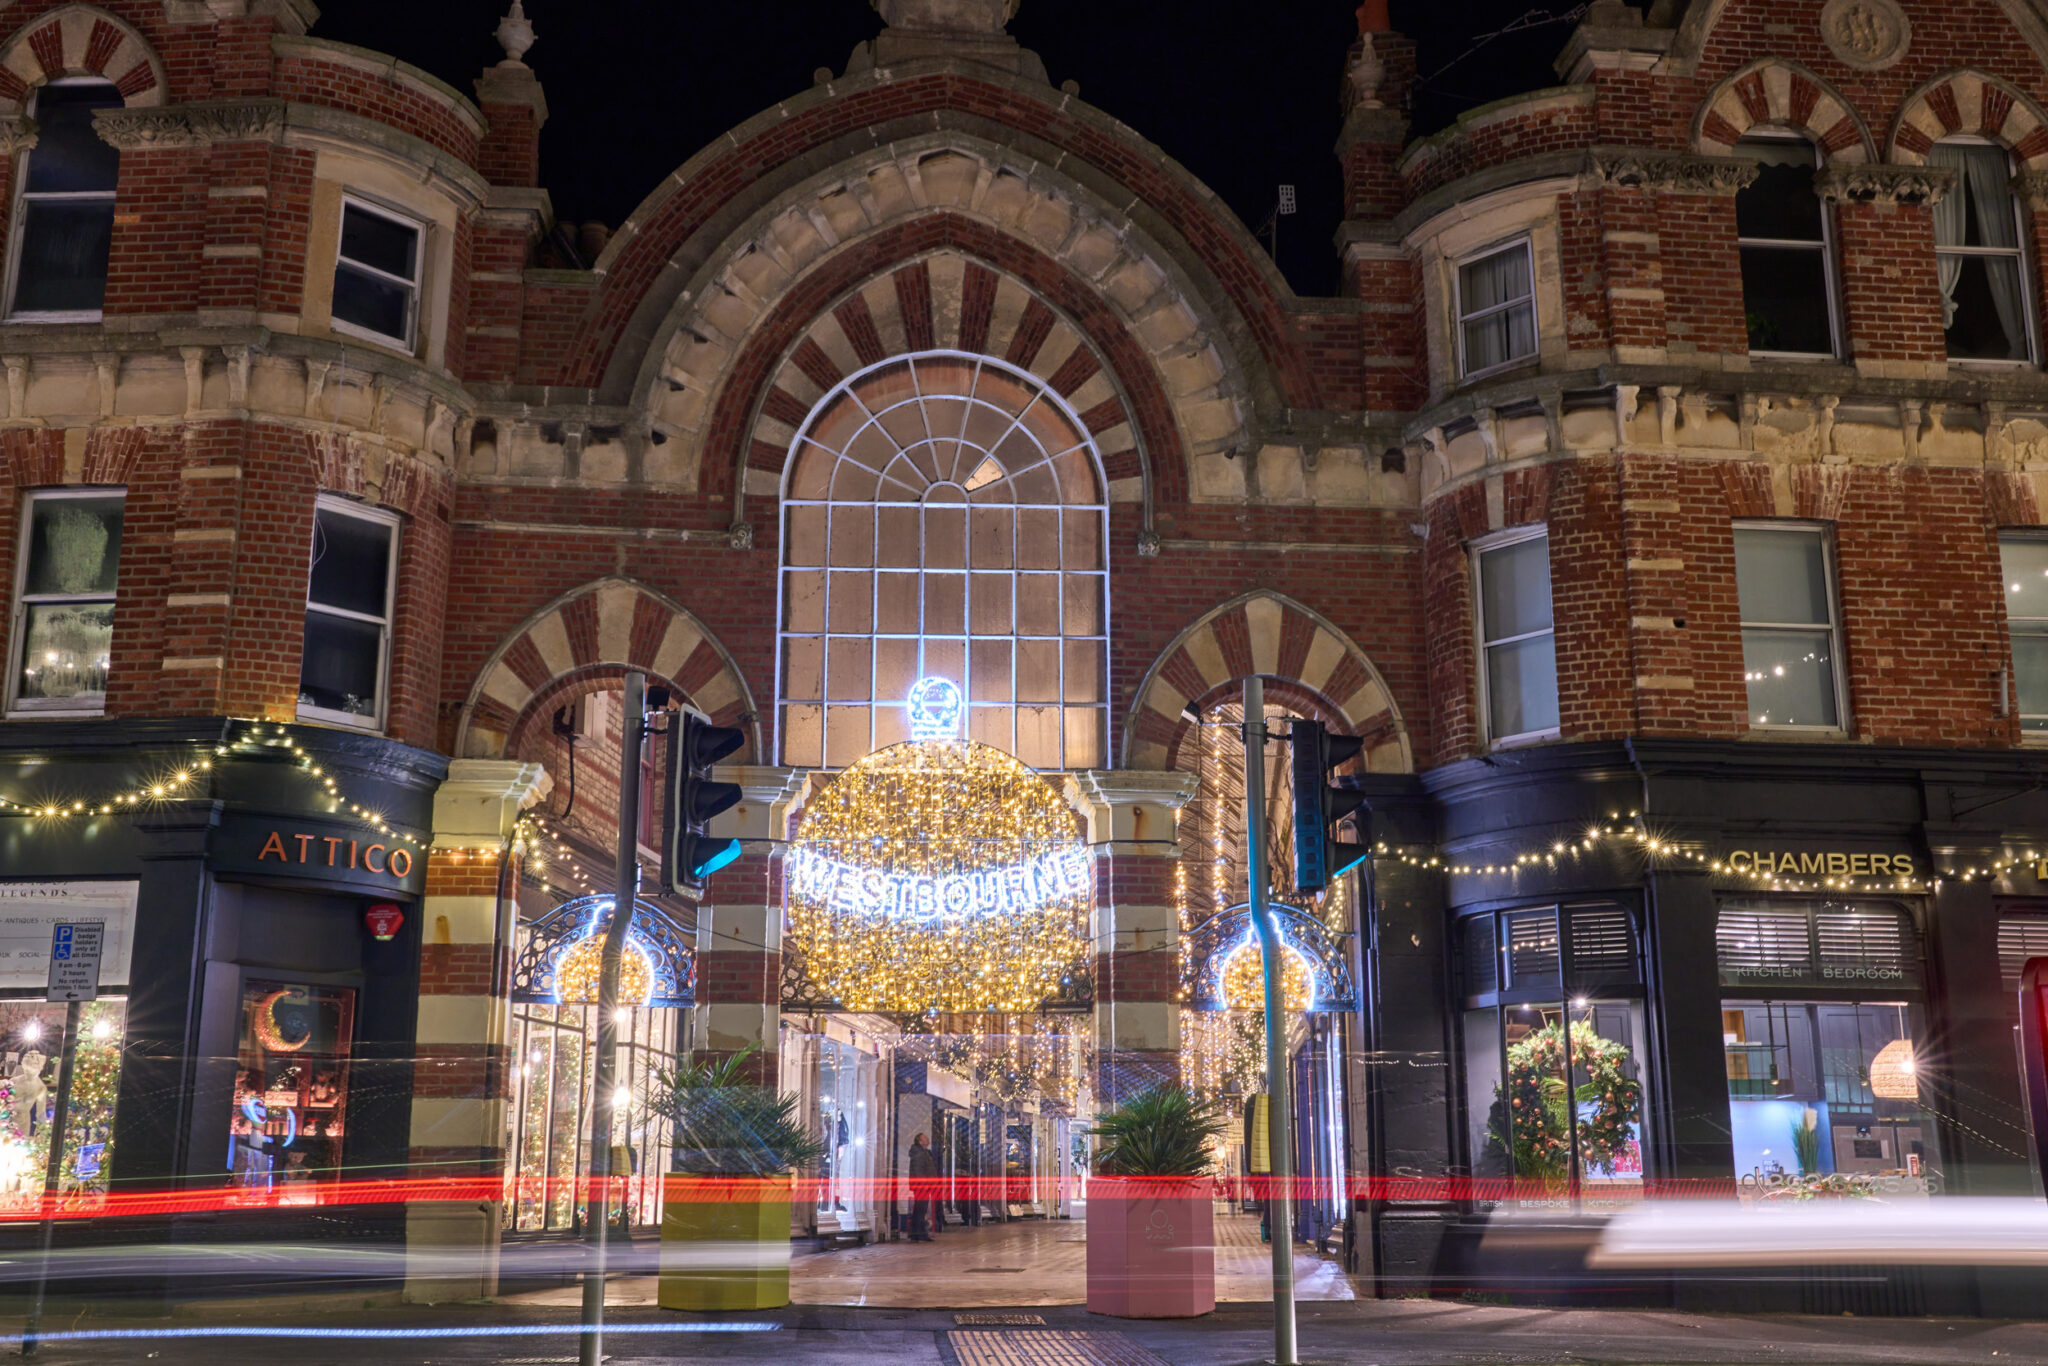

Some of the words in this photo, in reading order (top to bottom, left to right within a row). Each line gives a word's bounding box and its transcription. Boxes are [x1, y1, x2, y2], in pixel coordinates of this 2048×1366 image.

[257, 831, 413, 878] ATTICO
[1729, 850, 1914, 876] CHAMBERS
[788, 846, 1091, 919] WESTBOURNE
[1, 889, 68, 897] LEGENDS
[60, 928, 71, 941] P
[1736, 967, 1802, 978] KITCHEN
[1823, 967, 1903, 979] BEDROOM
[1741, 1173, 1823, 1192] 01202
[1519, 1200, 1570, 1208] BESPOKE
